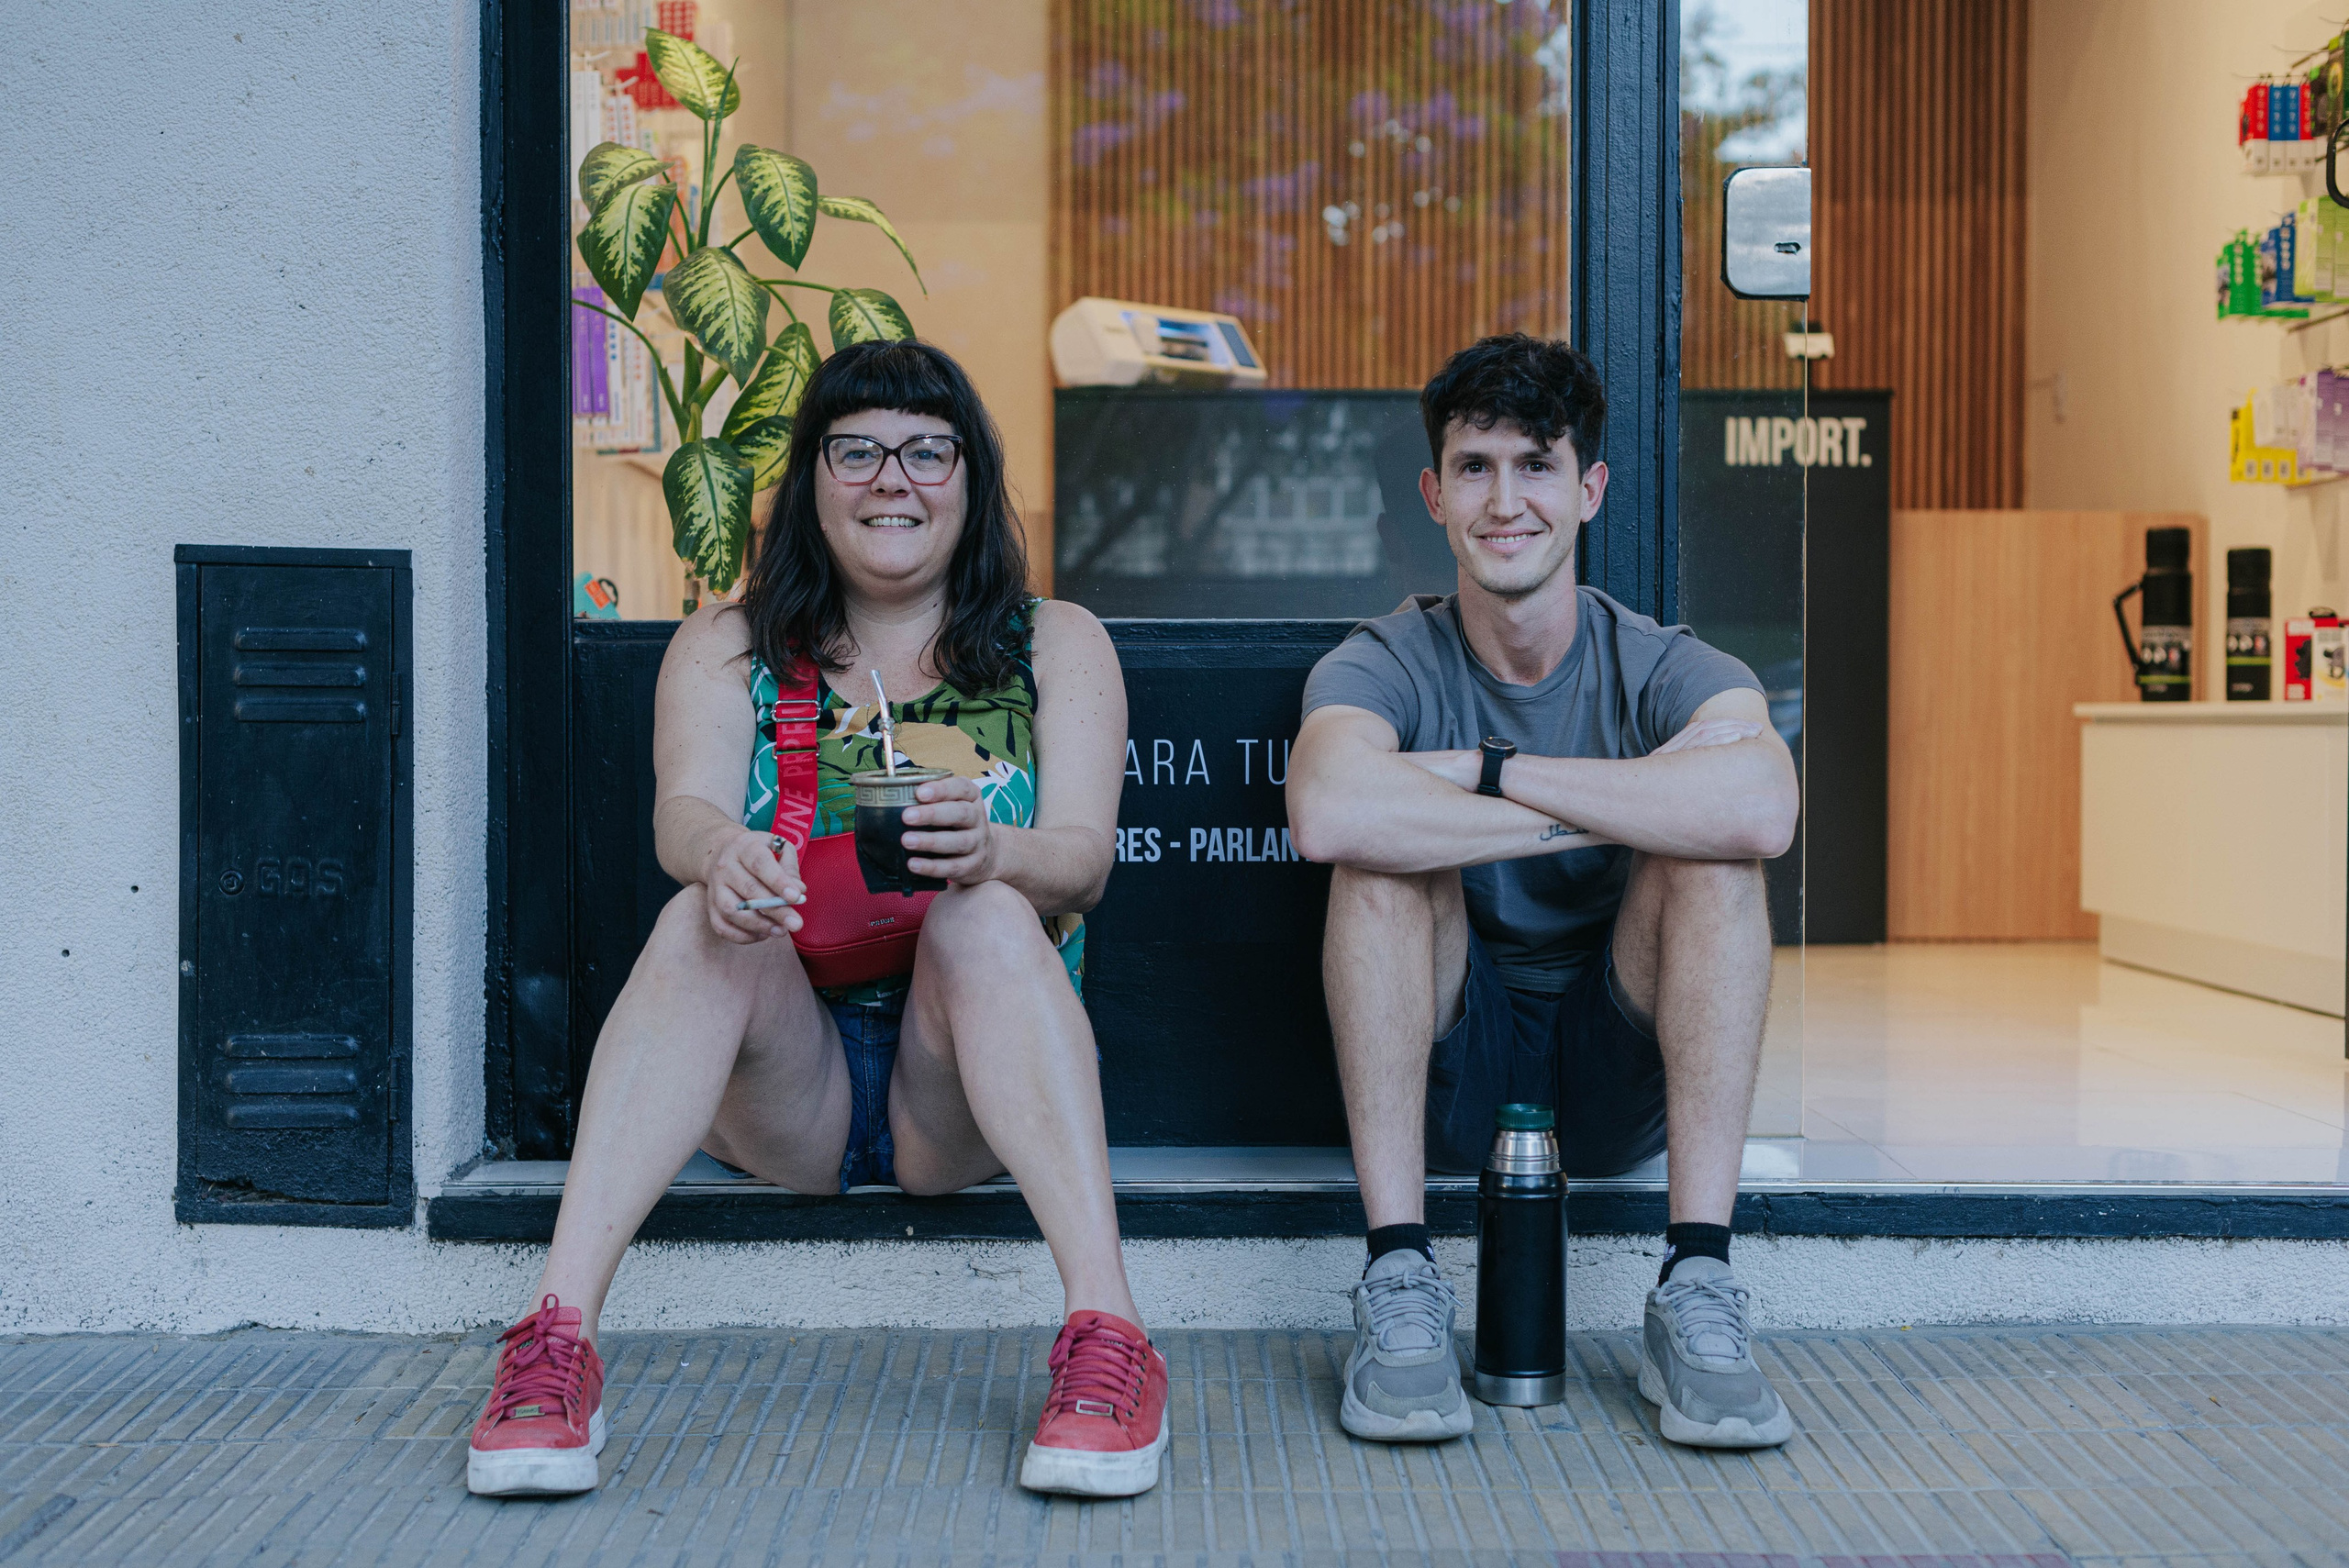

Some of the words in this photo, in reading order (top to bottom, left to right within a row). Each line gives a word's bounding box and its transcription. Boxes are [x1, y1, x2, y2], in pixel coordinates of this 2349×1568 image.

[1725, 417, 1873, 466] IMPORT.
[1124, 739, 1210, 785] ARA
[1236, 739, 1288, 785] TU
[1113, 827, 1162, 862] RES
[1190, 828, 1311, 862] PARLAN
